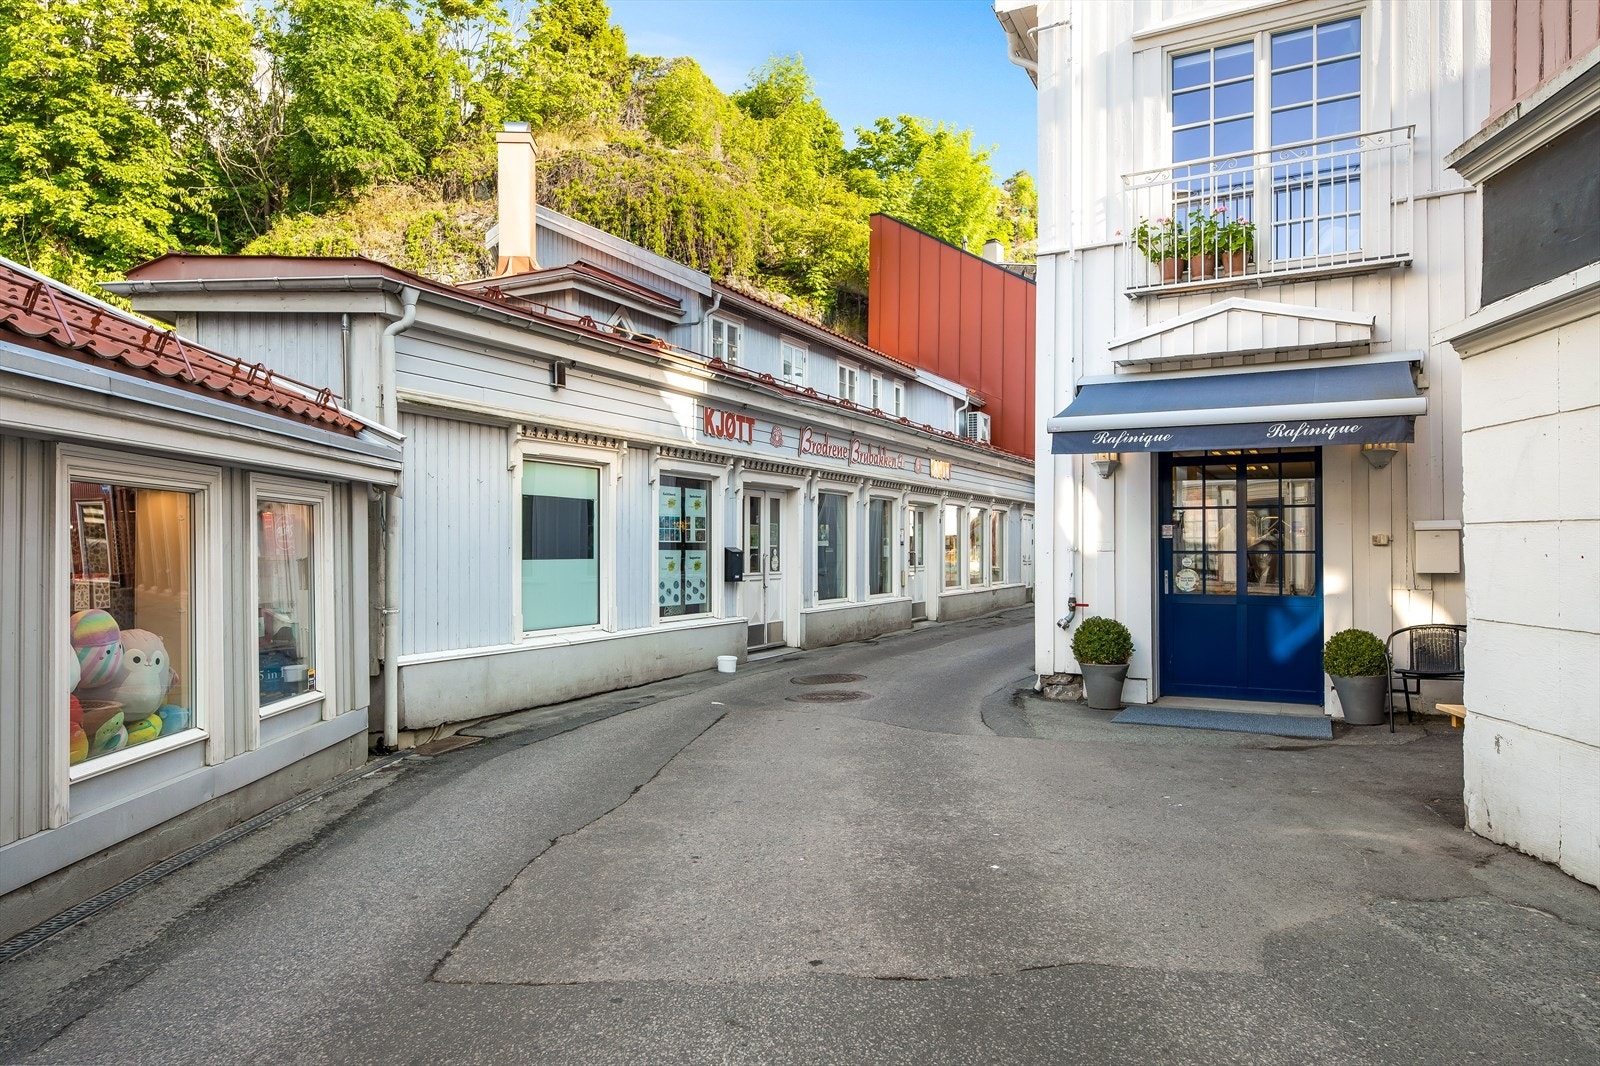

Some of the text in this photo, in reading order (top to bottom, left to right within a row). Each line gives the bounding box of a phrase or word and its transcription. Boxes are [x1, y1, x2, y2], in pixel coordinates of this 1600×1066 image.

[703, 406, 756, 445] KJØTT
[1092, 430, 1174, 449] Rafinique
[1266, 421, 1363, 443] Rafinique
[799, 426, 848, 459] Brødrene
[849, 438, 897, 469] Brubakken
